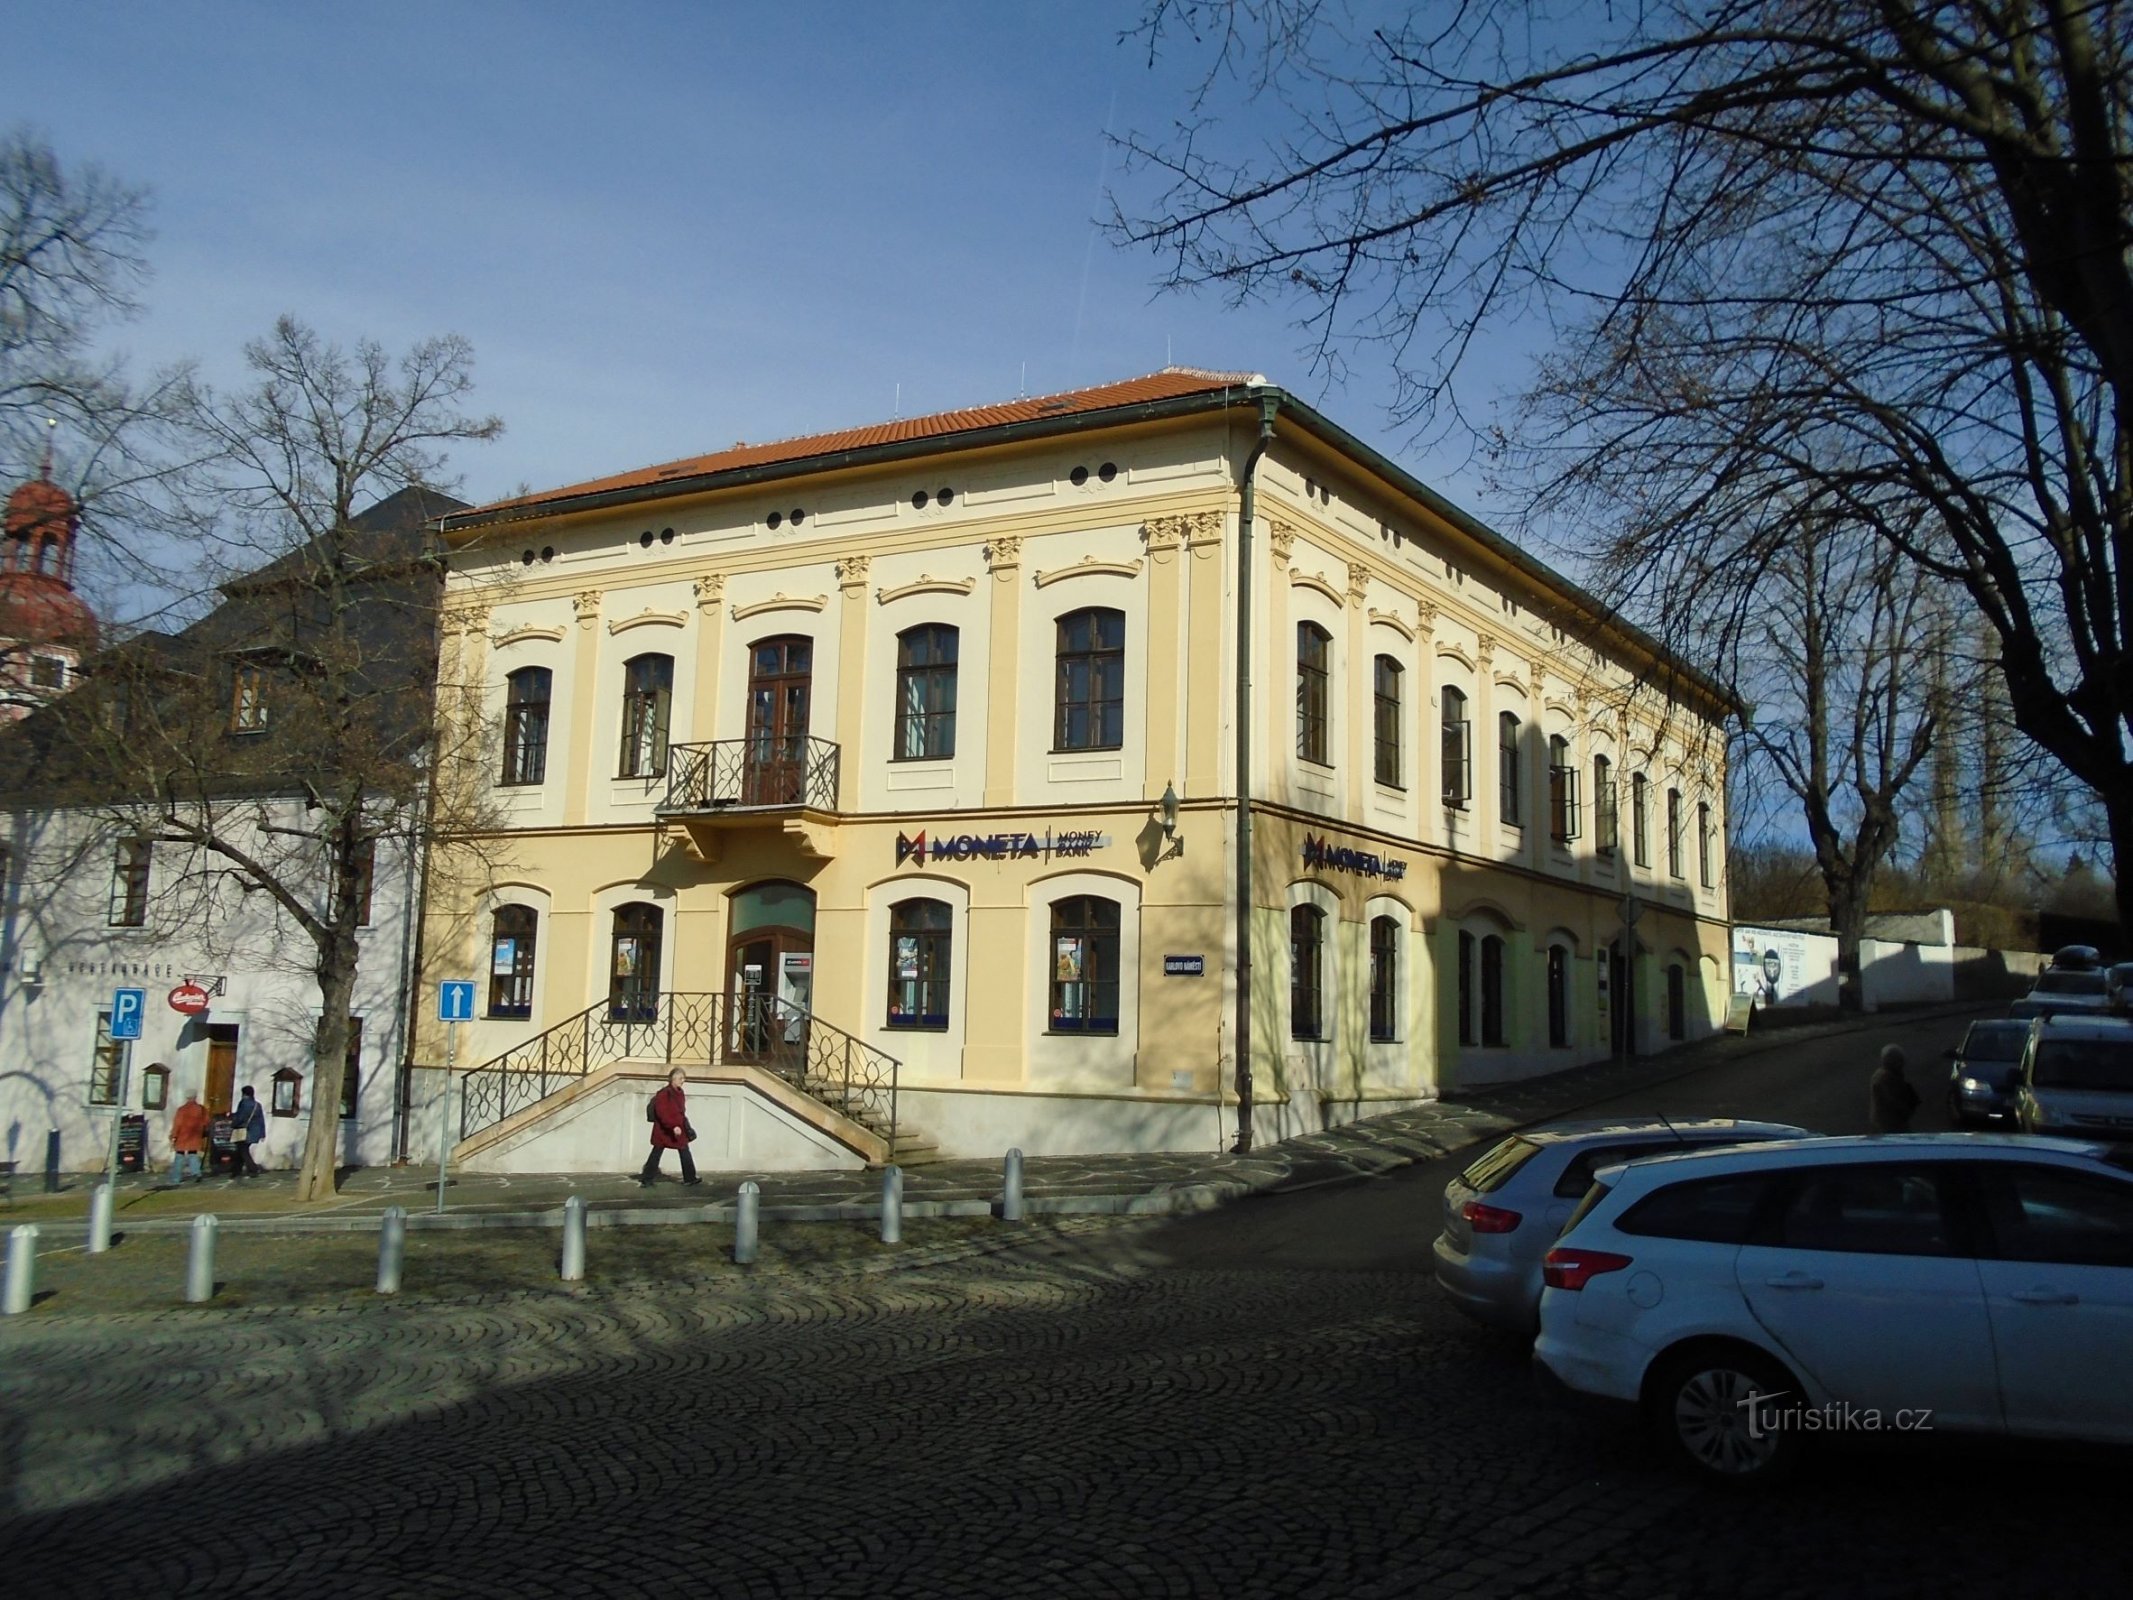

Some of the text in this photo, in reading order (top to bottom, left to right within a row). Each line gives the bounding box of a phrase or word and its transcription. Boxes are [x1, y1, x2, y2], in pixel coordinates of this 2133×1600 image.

[932, 833, 1040, 861] MONETA
[1057, 830, 1103, 844] MONEY
[1325, 844, 1381, 879] MONETA
[117, 994, 137, 1023] P
